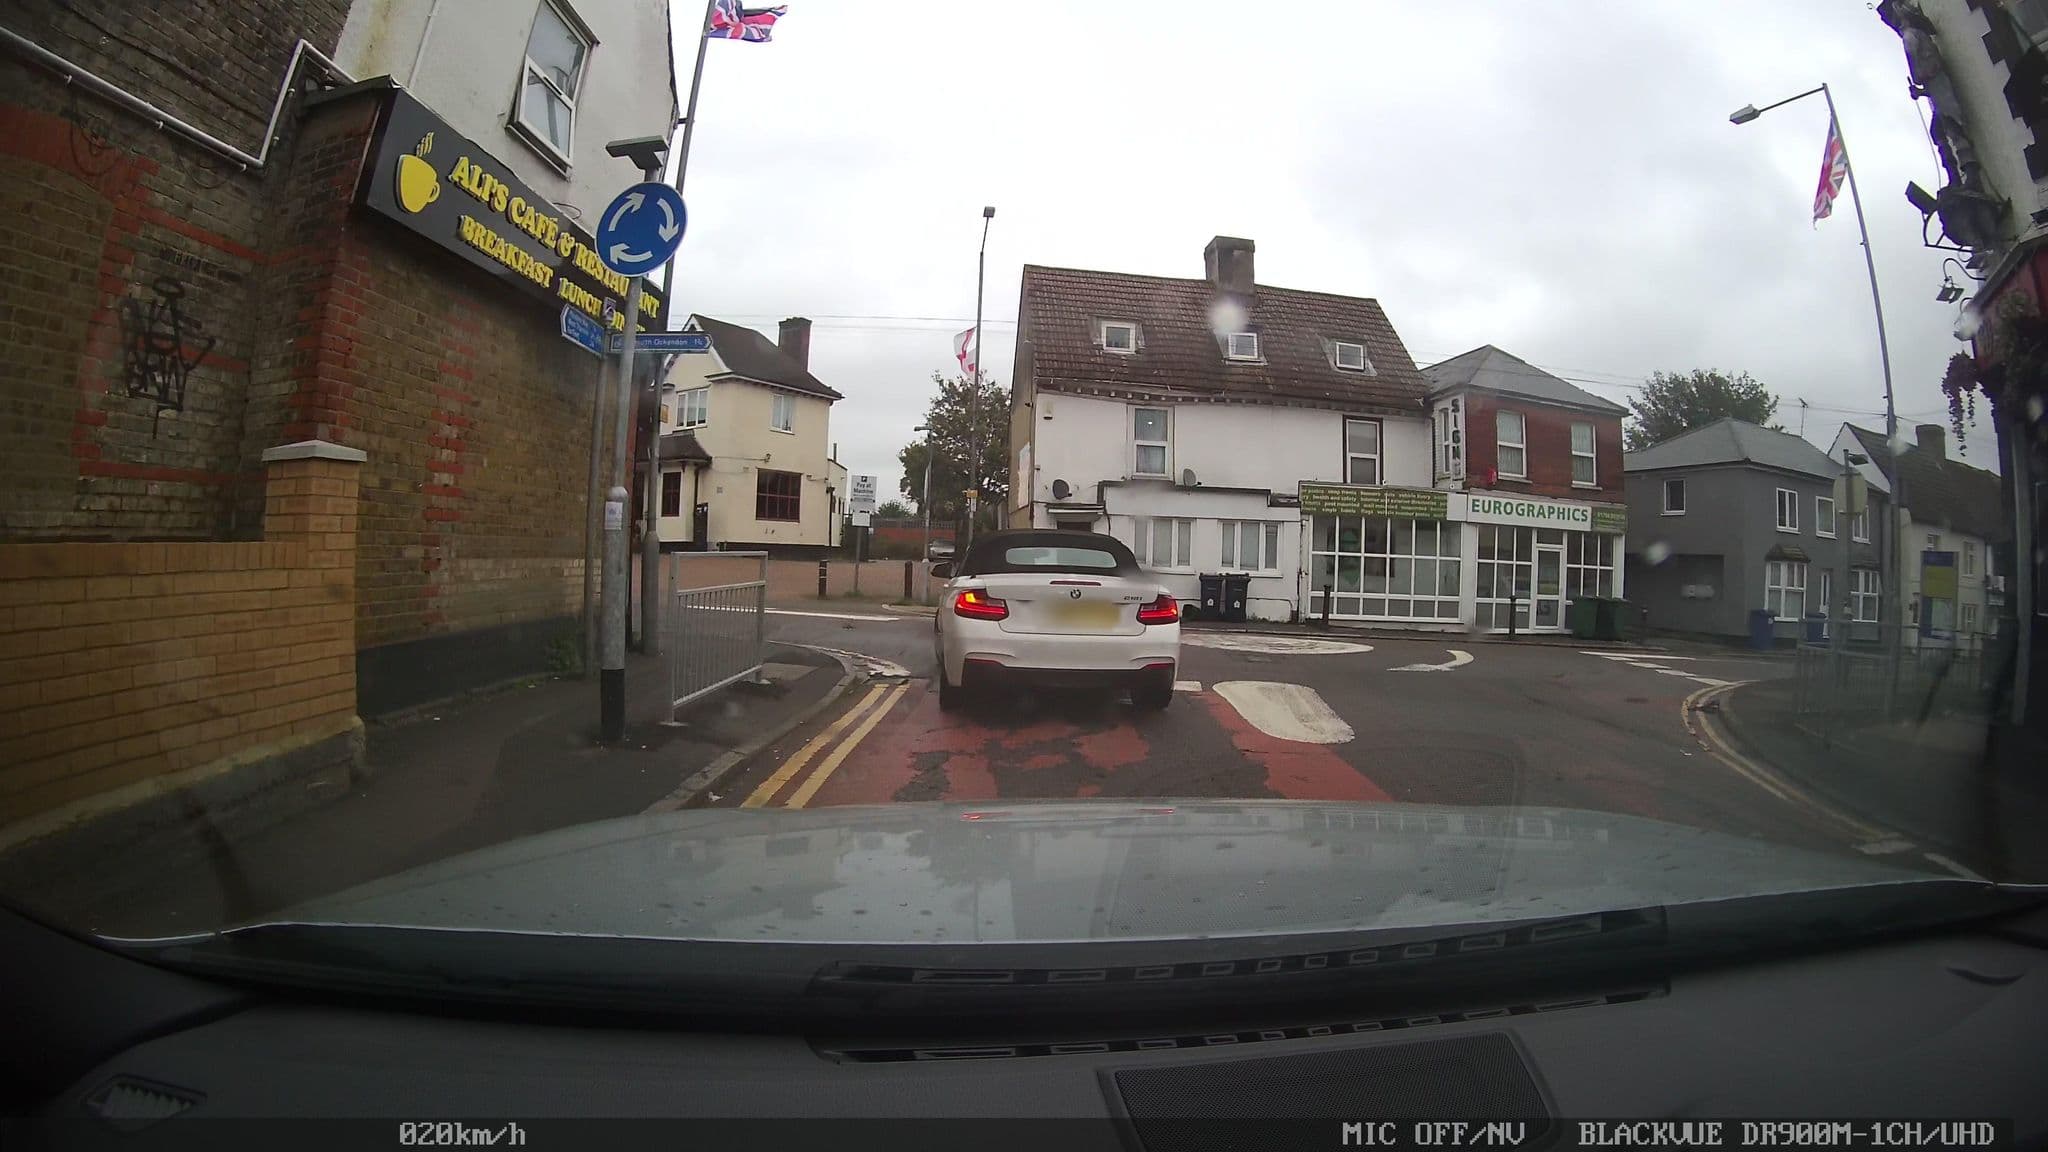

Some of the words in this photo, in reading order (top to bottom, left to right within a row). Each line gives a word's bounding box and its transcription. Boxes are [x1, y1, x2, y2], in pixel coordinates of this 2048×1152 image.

[449, 156, 510, 212] ALI'S
[508, 196, 559, 249] CAFÉ
[557, 231, 576, 258] &
[575, 243, 660, 319] RESTAUANT
[461, 216, 554, 288] BREAKFAST
[558, 277, 603, 318] LUNCH
[654, 337, 688, 347] Ockendon
[1471, 498, 1589, 523] EUROGRAPHICS
